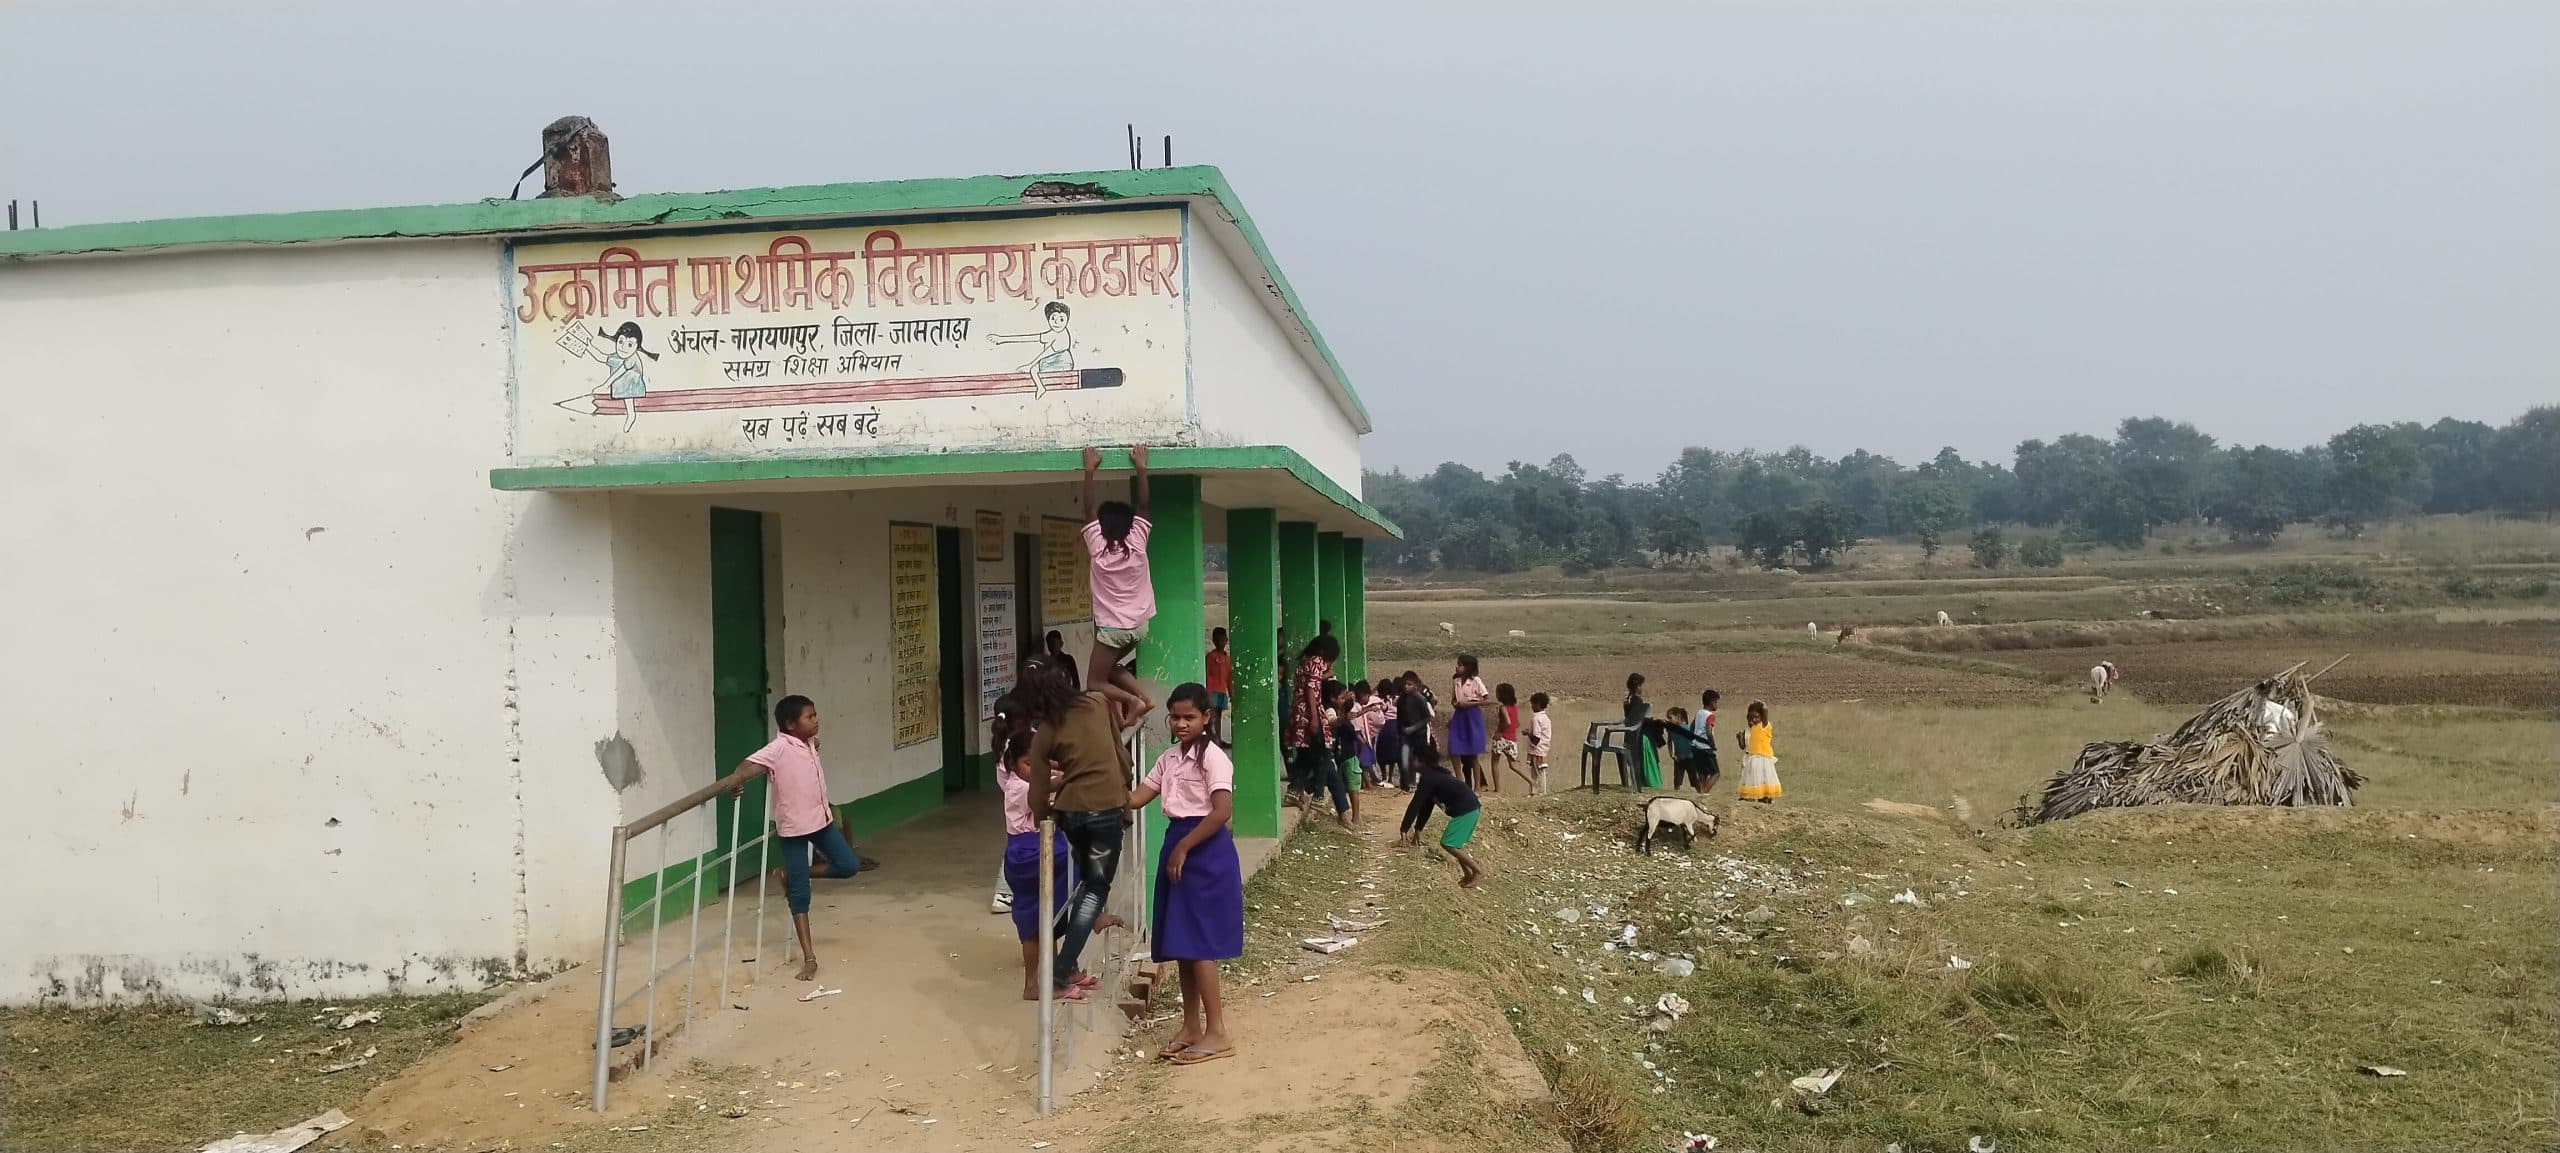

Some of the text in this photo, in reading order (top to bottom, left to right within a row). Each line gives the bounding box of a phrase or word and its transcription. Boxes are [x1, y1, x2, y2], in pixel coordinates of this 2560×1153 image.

[517, 246, 679, 325] उत्क्रमित
[686, 235, 856, 318] प्राथमिक
[889, 317, 971, 350] जामताड़ा
[722, 350, 903, 382] समग्र शिक्षा अभियान
[816, 413, 849, 437] सब
